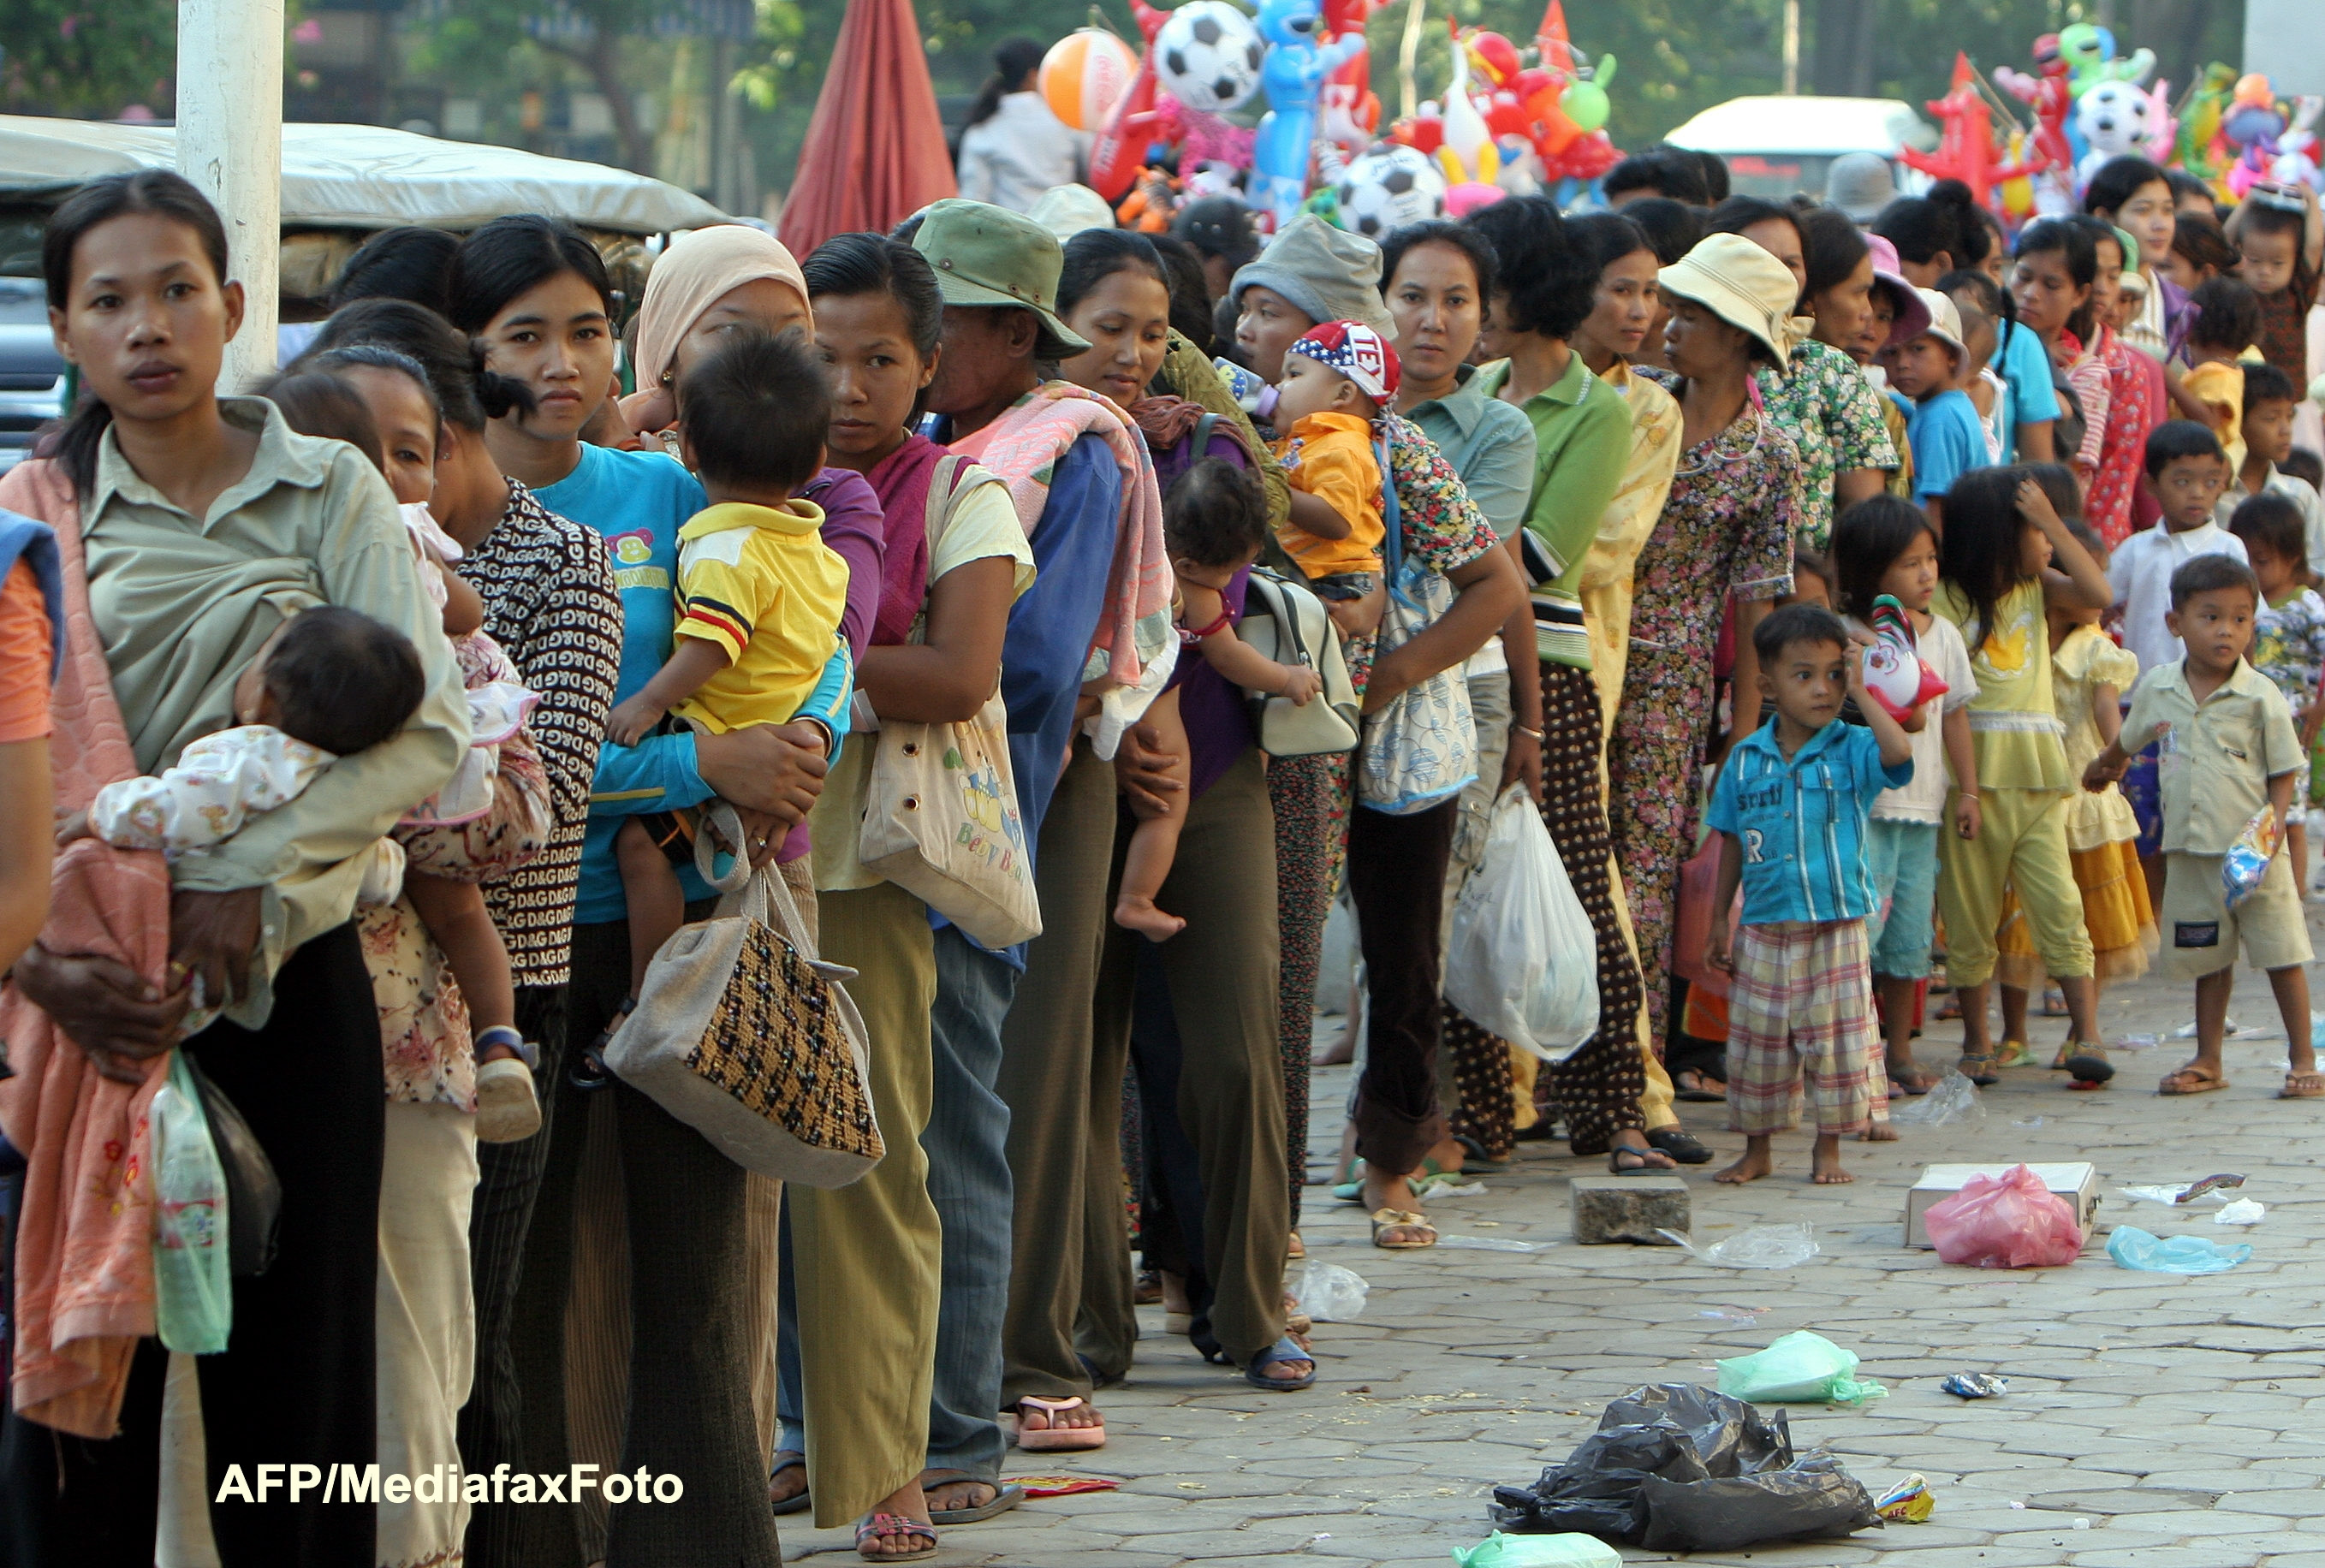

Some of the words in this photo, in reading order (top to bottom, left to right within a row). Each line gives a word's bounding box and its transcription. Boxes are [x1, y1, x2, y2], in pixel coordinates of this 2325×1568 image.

[528, 868, 556, 885] D&G
[517, 889, 548, 908] D&G
[527, 909, 555, 928] D&G
[517, 930, 547, 949] D&G
[529, 949, 556, 967] D&G
[522, 968, 552, 986] D&G
